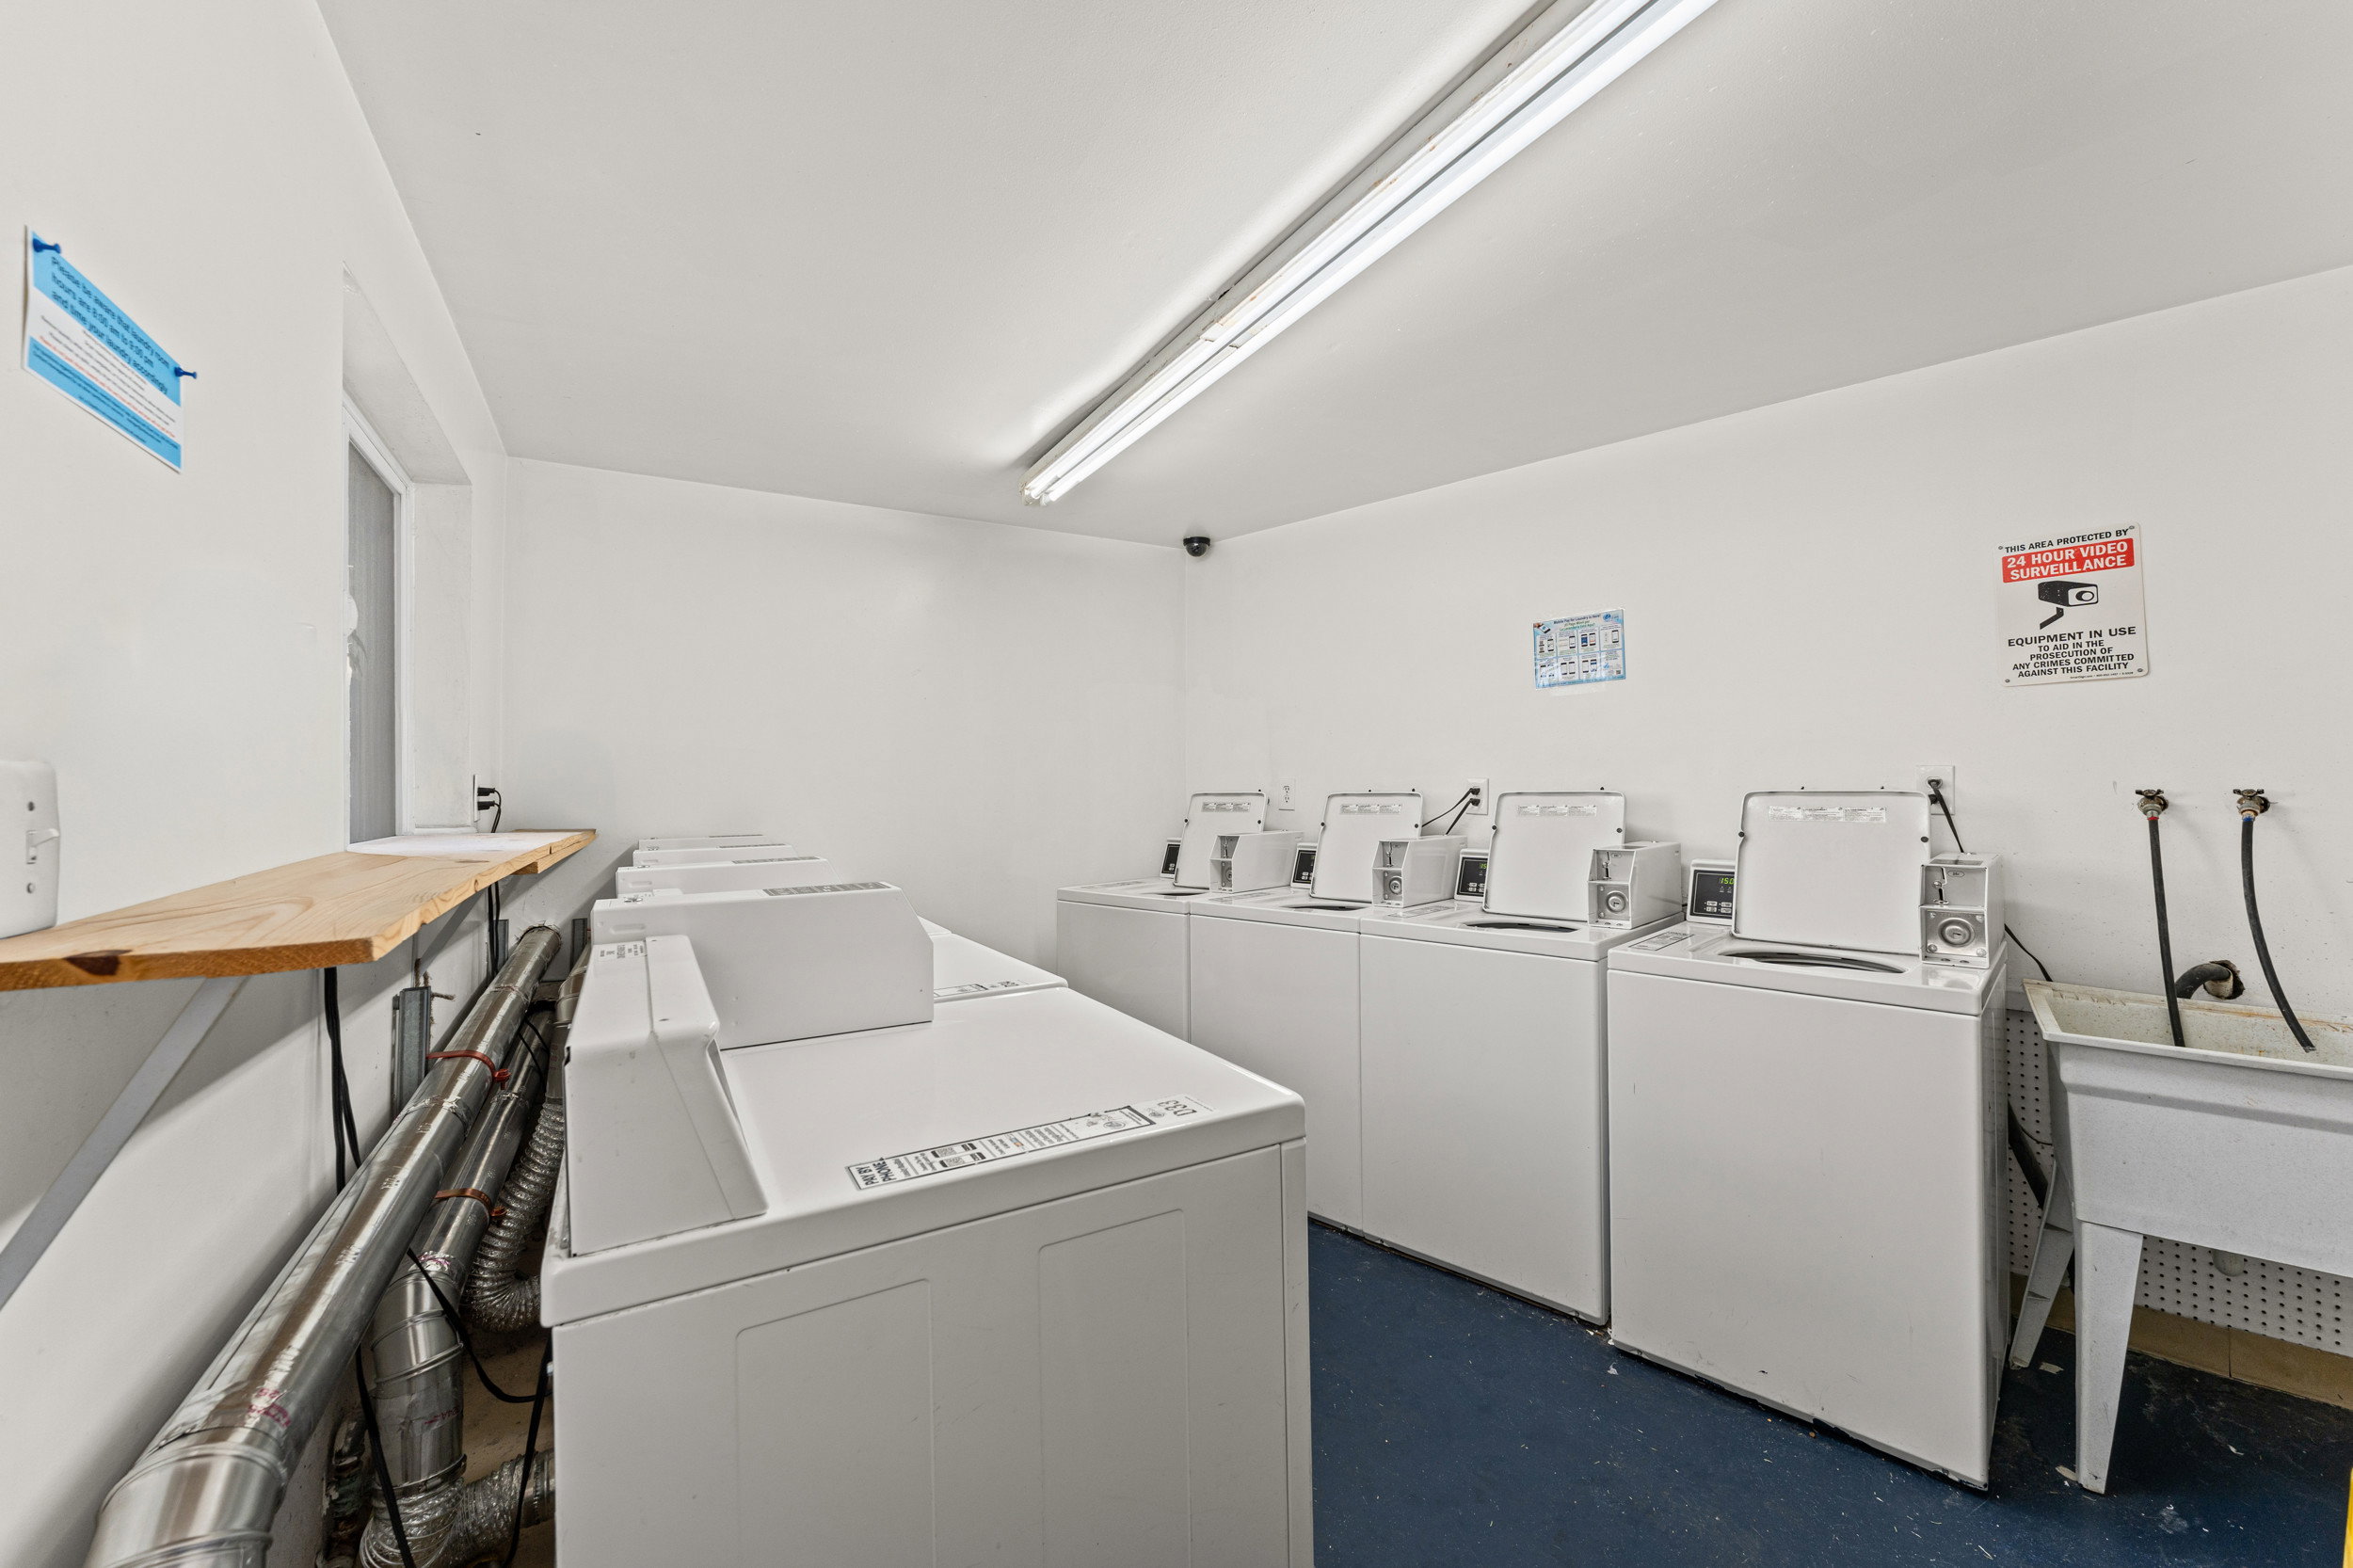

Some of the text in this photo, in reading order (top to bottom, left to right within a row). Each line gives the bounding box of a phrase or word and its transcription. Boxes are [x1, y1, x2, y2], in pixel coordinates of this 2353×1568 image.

[52, 271, 76, 300] hours
[77, 296, 91, 313] are
[108, 325, 120, 339] am
[121, 332, 128, 345] to
[52, 256, 80, 288] Please
[82, 283, 92, 298] be
[93, 296, 115, 320] aware
[131, 327, 153, 356] laundry
[154, 351, 169, 369] room
[52, 291, 69, 310] and
[105, 334, 131, 364] laundry
[2005, 528, 2129, 553] THIS AREA PROTECTED BY
[2007, 541, 2128, 568] 24 HOUR VIDEO
[2010, 554, 2127, 581] SURVEILLANCE
[2008, 626, 2137, 647] EQUIPMENT IN USE
[2052, 643, 2069, 651] AID
[2085, 639, 2105, 648] THE
[2012, 653, 2135, 671] ANY CRIMES COMMITTED
[2029, 647, 2113, 661] PROSECUTION OF
[2017, 668, 2058, 679] AGAINST
[2060, 665, 2083, 674] THIS
[2086, 662, 2129, 672] FACILITY
[1158, 1100, 1197, 1116] D33
[856, 1166, 879, 1186] PAY BY
[872, 1160, 897, 1182] PHONE
